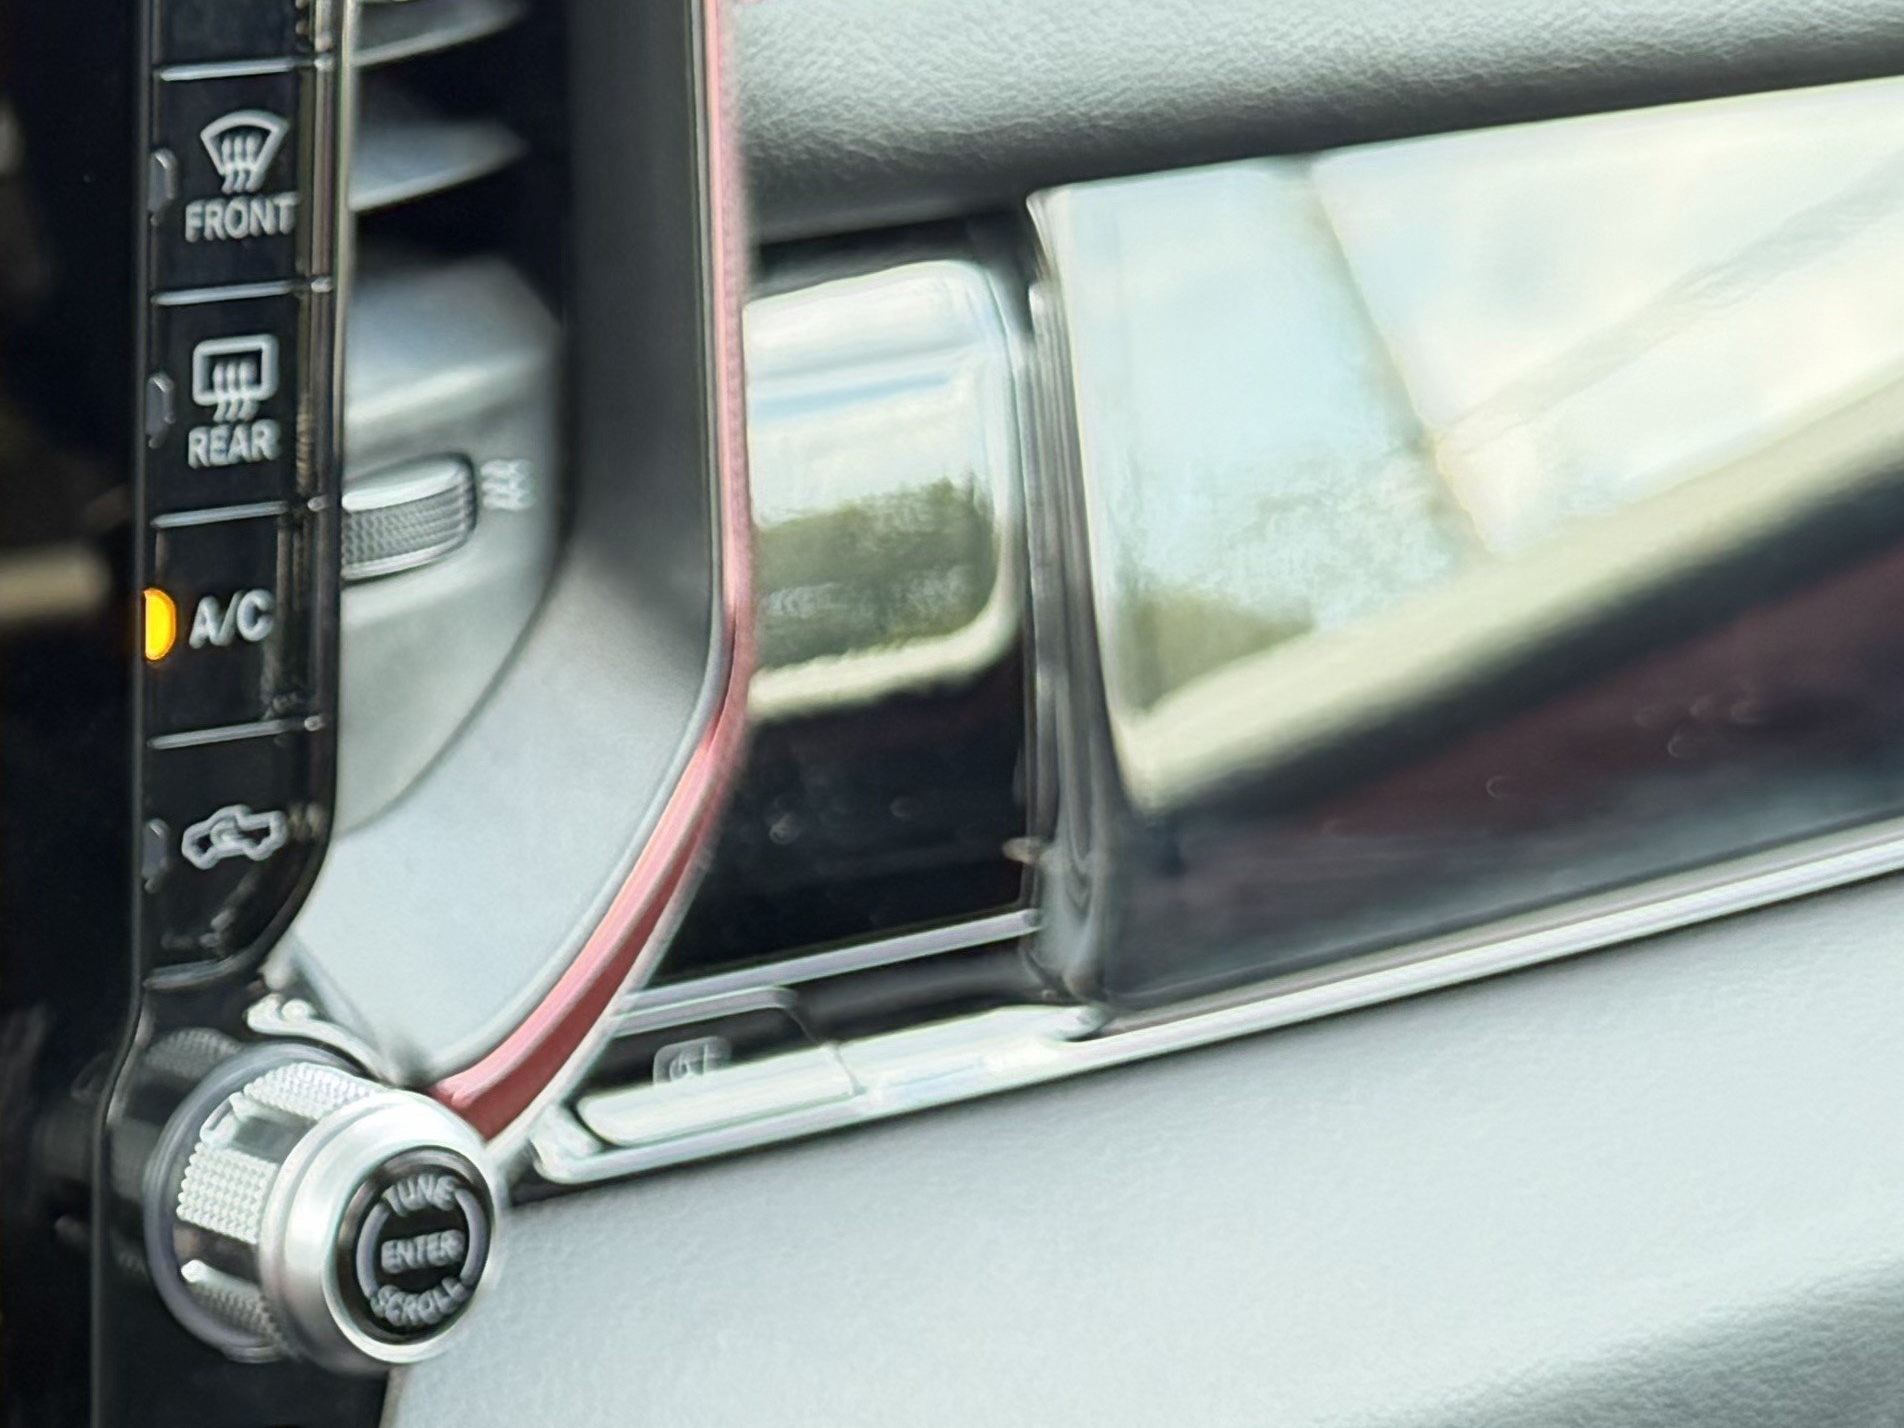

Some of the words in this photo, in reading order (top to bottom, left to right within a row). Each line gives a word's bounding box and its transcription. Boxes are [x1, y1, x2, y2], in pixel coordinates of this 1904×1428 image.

[185, 194, 296, 242] FRONT
[188, 420, 282, 468] REAR
[189, 590, 275, 647] A/C
[381, 1173, 458, 1217] TUNE
[380, 1228, 465, 1274] ENTER
[370, 1277, 469, 1326] SCROLL
